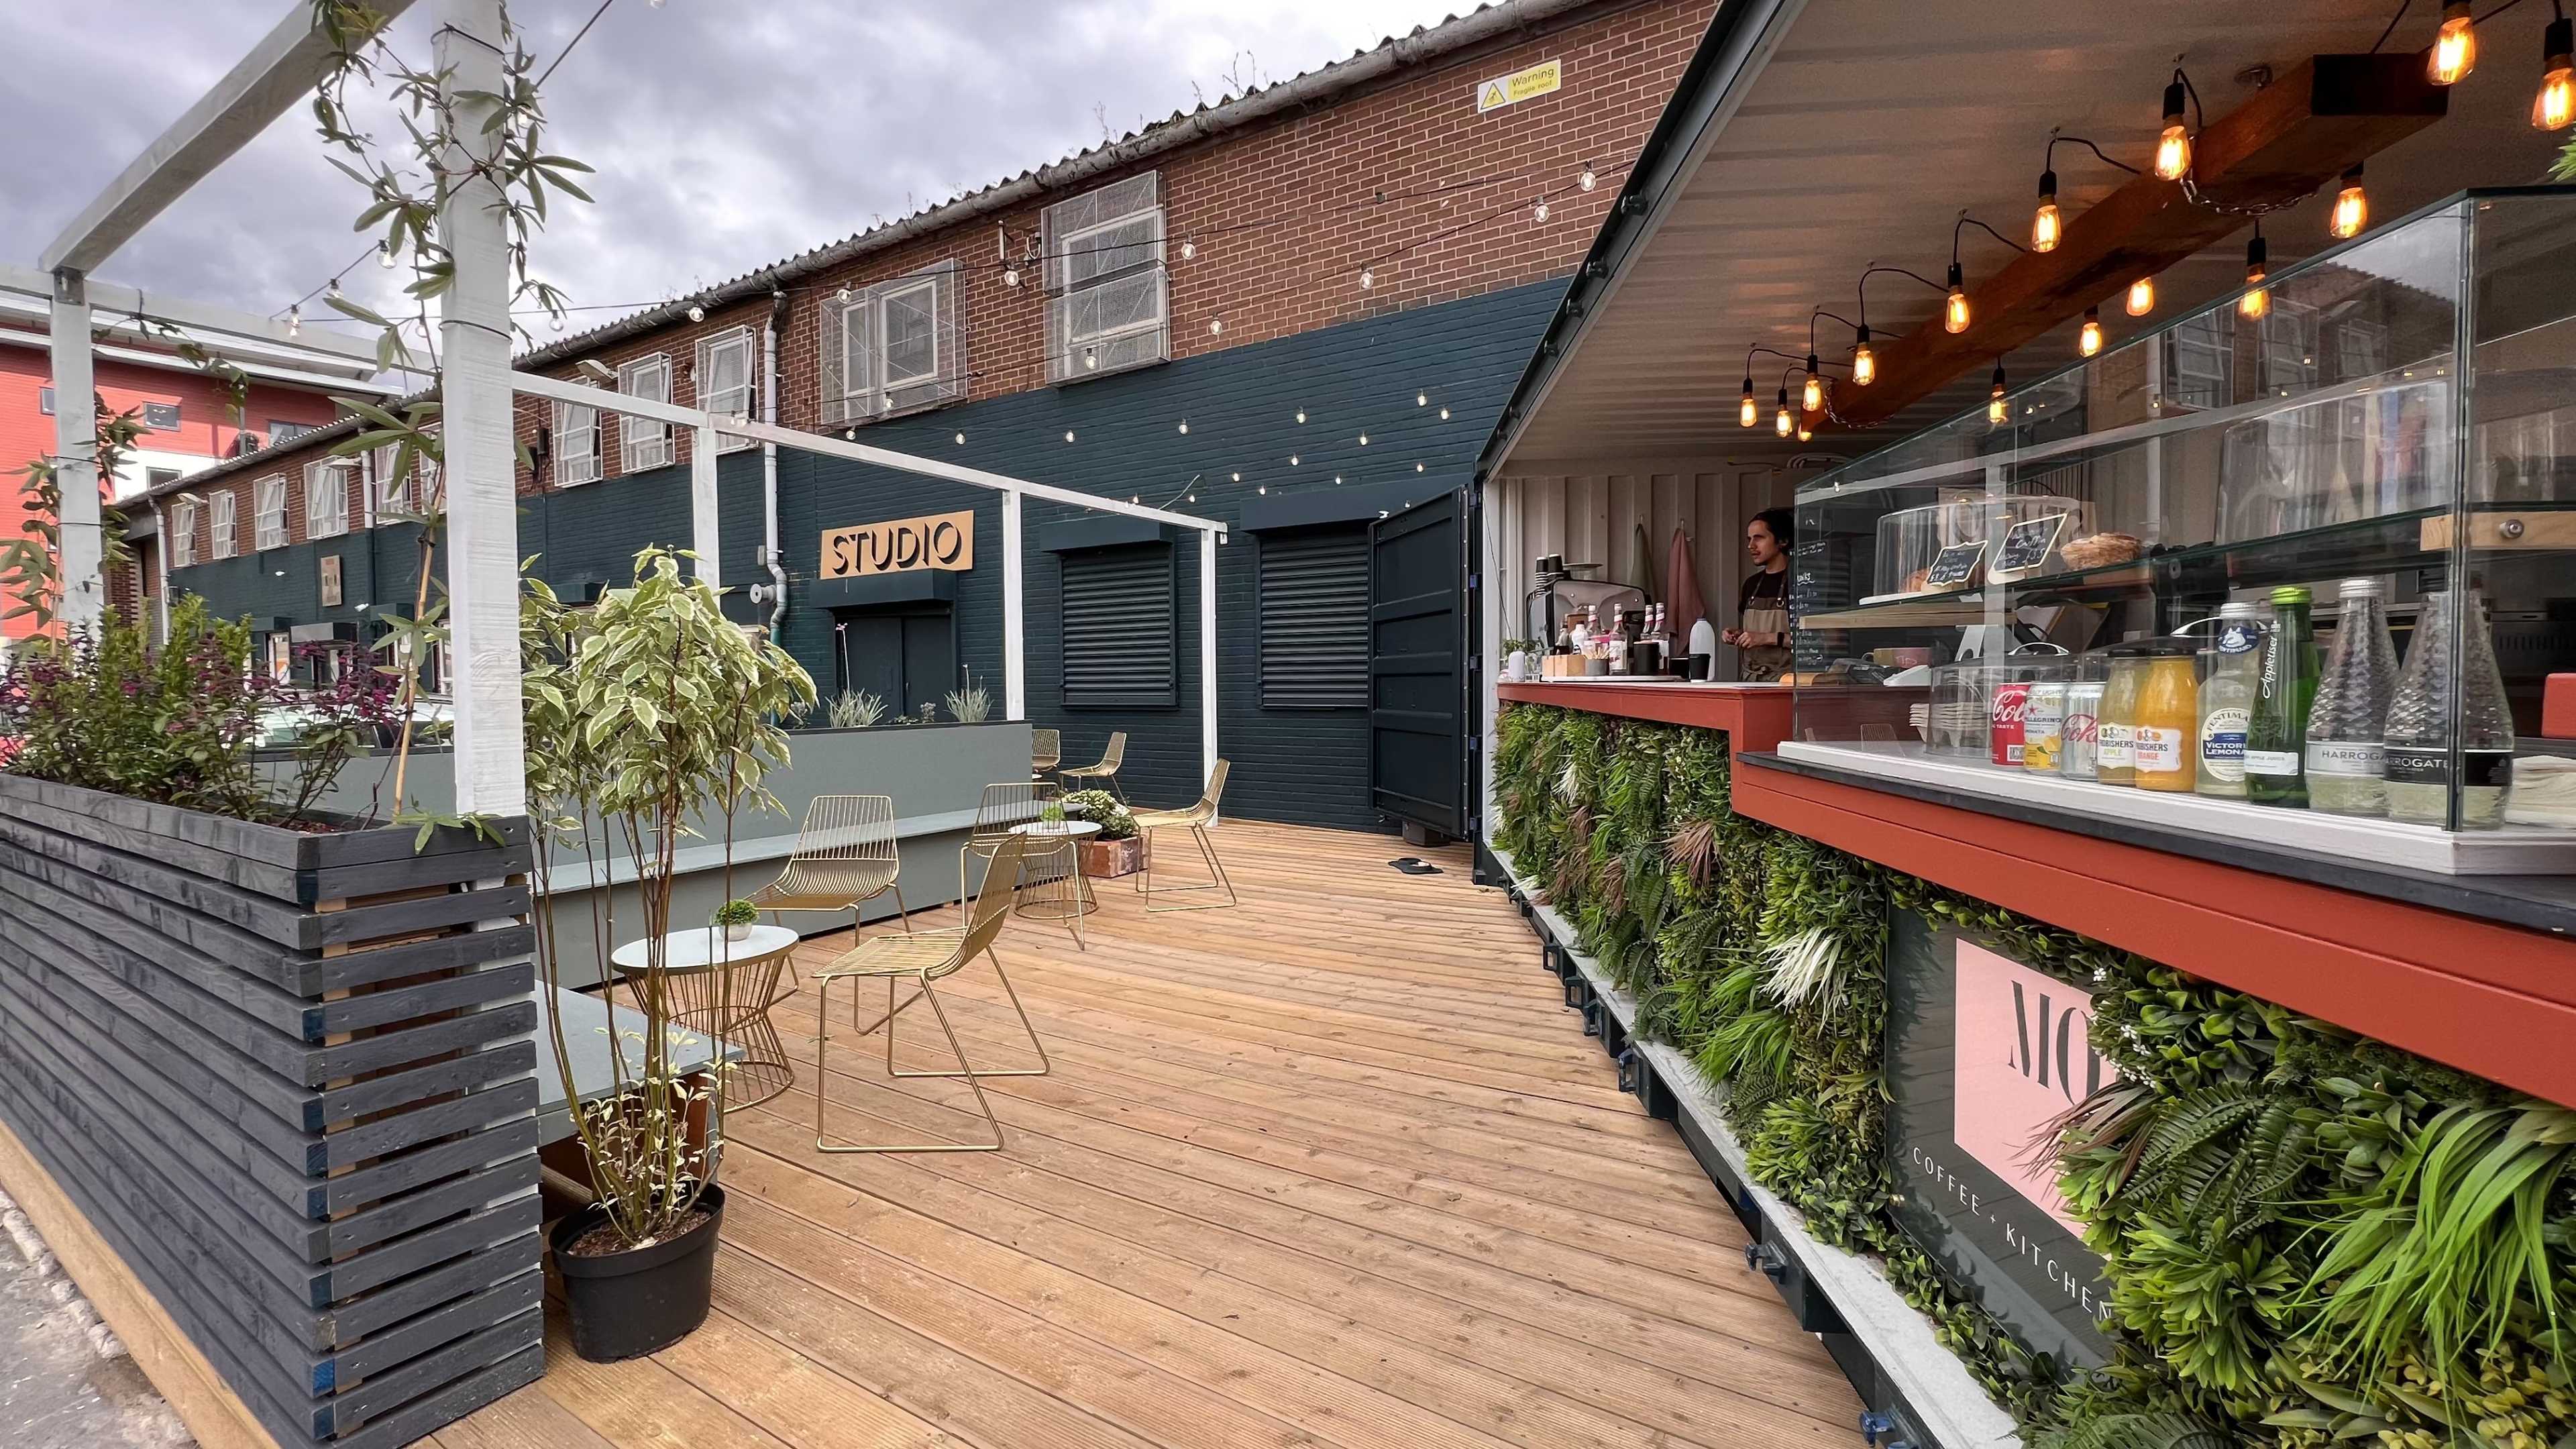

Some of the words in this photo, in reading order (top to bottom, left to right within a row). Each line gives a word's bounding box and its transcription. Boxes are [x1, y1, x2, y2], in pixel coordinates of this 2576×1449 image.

[1512, 68, 1554, 87] Warning
[1513, 86, 1536, 97] Fragile
[1538, 80, 1552, 89] roof
[833, 521, 962, 575] STUDIO
[2207, 712, 2248, 731] FENTIMA
[1913, 1147, 1980, 1216] COFFEE
[2006, 1223, 2112, 1321] KITCHEN
